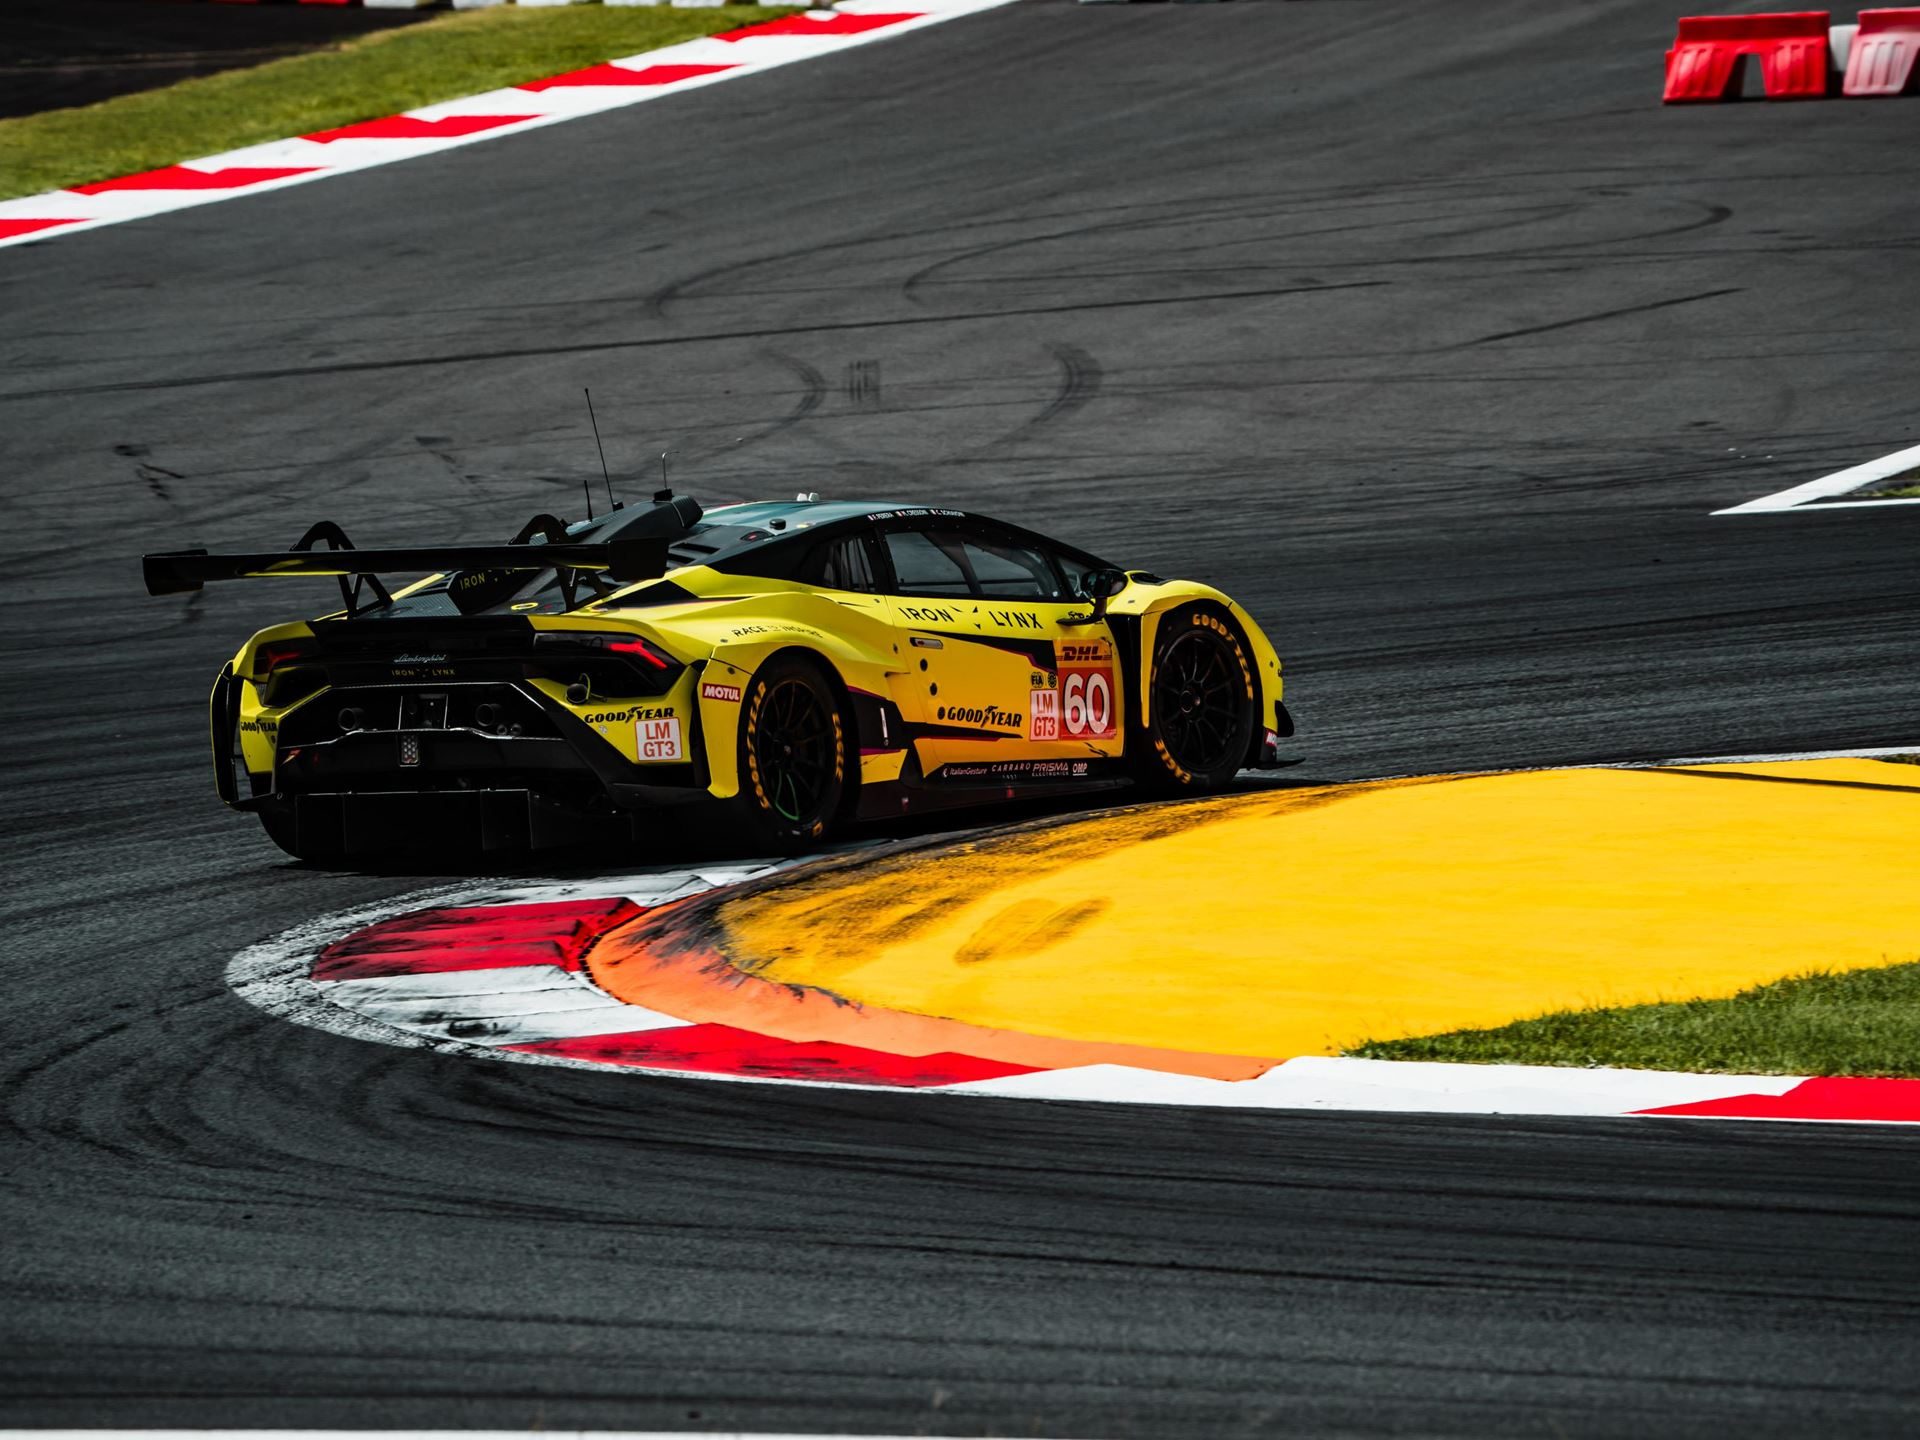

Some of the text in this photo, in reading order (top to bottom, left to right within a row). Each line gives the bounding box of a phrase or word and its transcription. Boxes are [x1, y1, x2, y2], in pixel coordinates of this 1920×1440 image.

[460, 572, 486, 590] IRON
[898, 607, 1044, 629] IRON LYNX
[732, 626, 768, 637] RACE
[1062, 646, 1104, 661] DHL
[391, 668, 456, 677] IRON LYNX
[704, 685, 740, 701] MOTUL
[1036, 693, 1054, 714] LM
[1064, 672, 1111, 735] 60
[584, 706, 675, 723] GOODYEAR
[947, 706, 1023, 728] GOODYEAR
[645, 721, 671, 741] LM
[1034, 716, 1056, 737] GT3
[643, 740, 676, 757] GT3
[991, 763, 1031, 773] CARRARO
[1033, 762, 1069, 772] PRISMA
[1072, 762, 1088, 773] OMP
